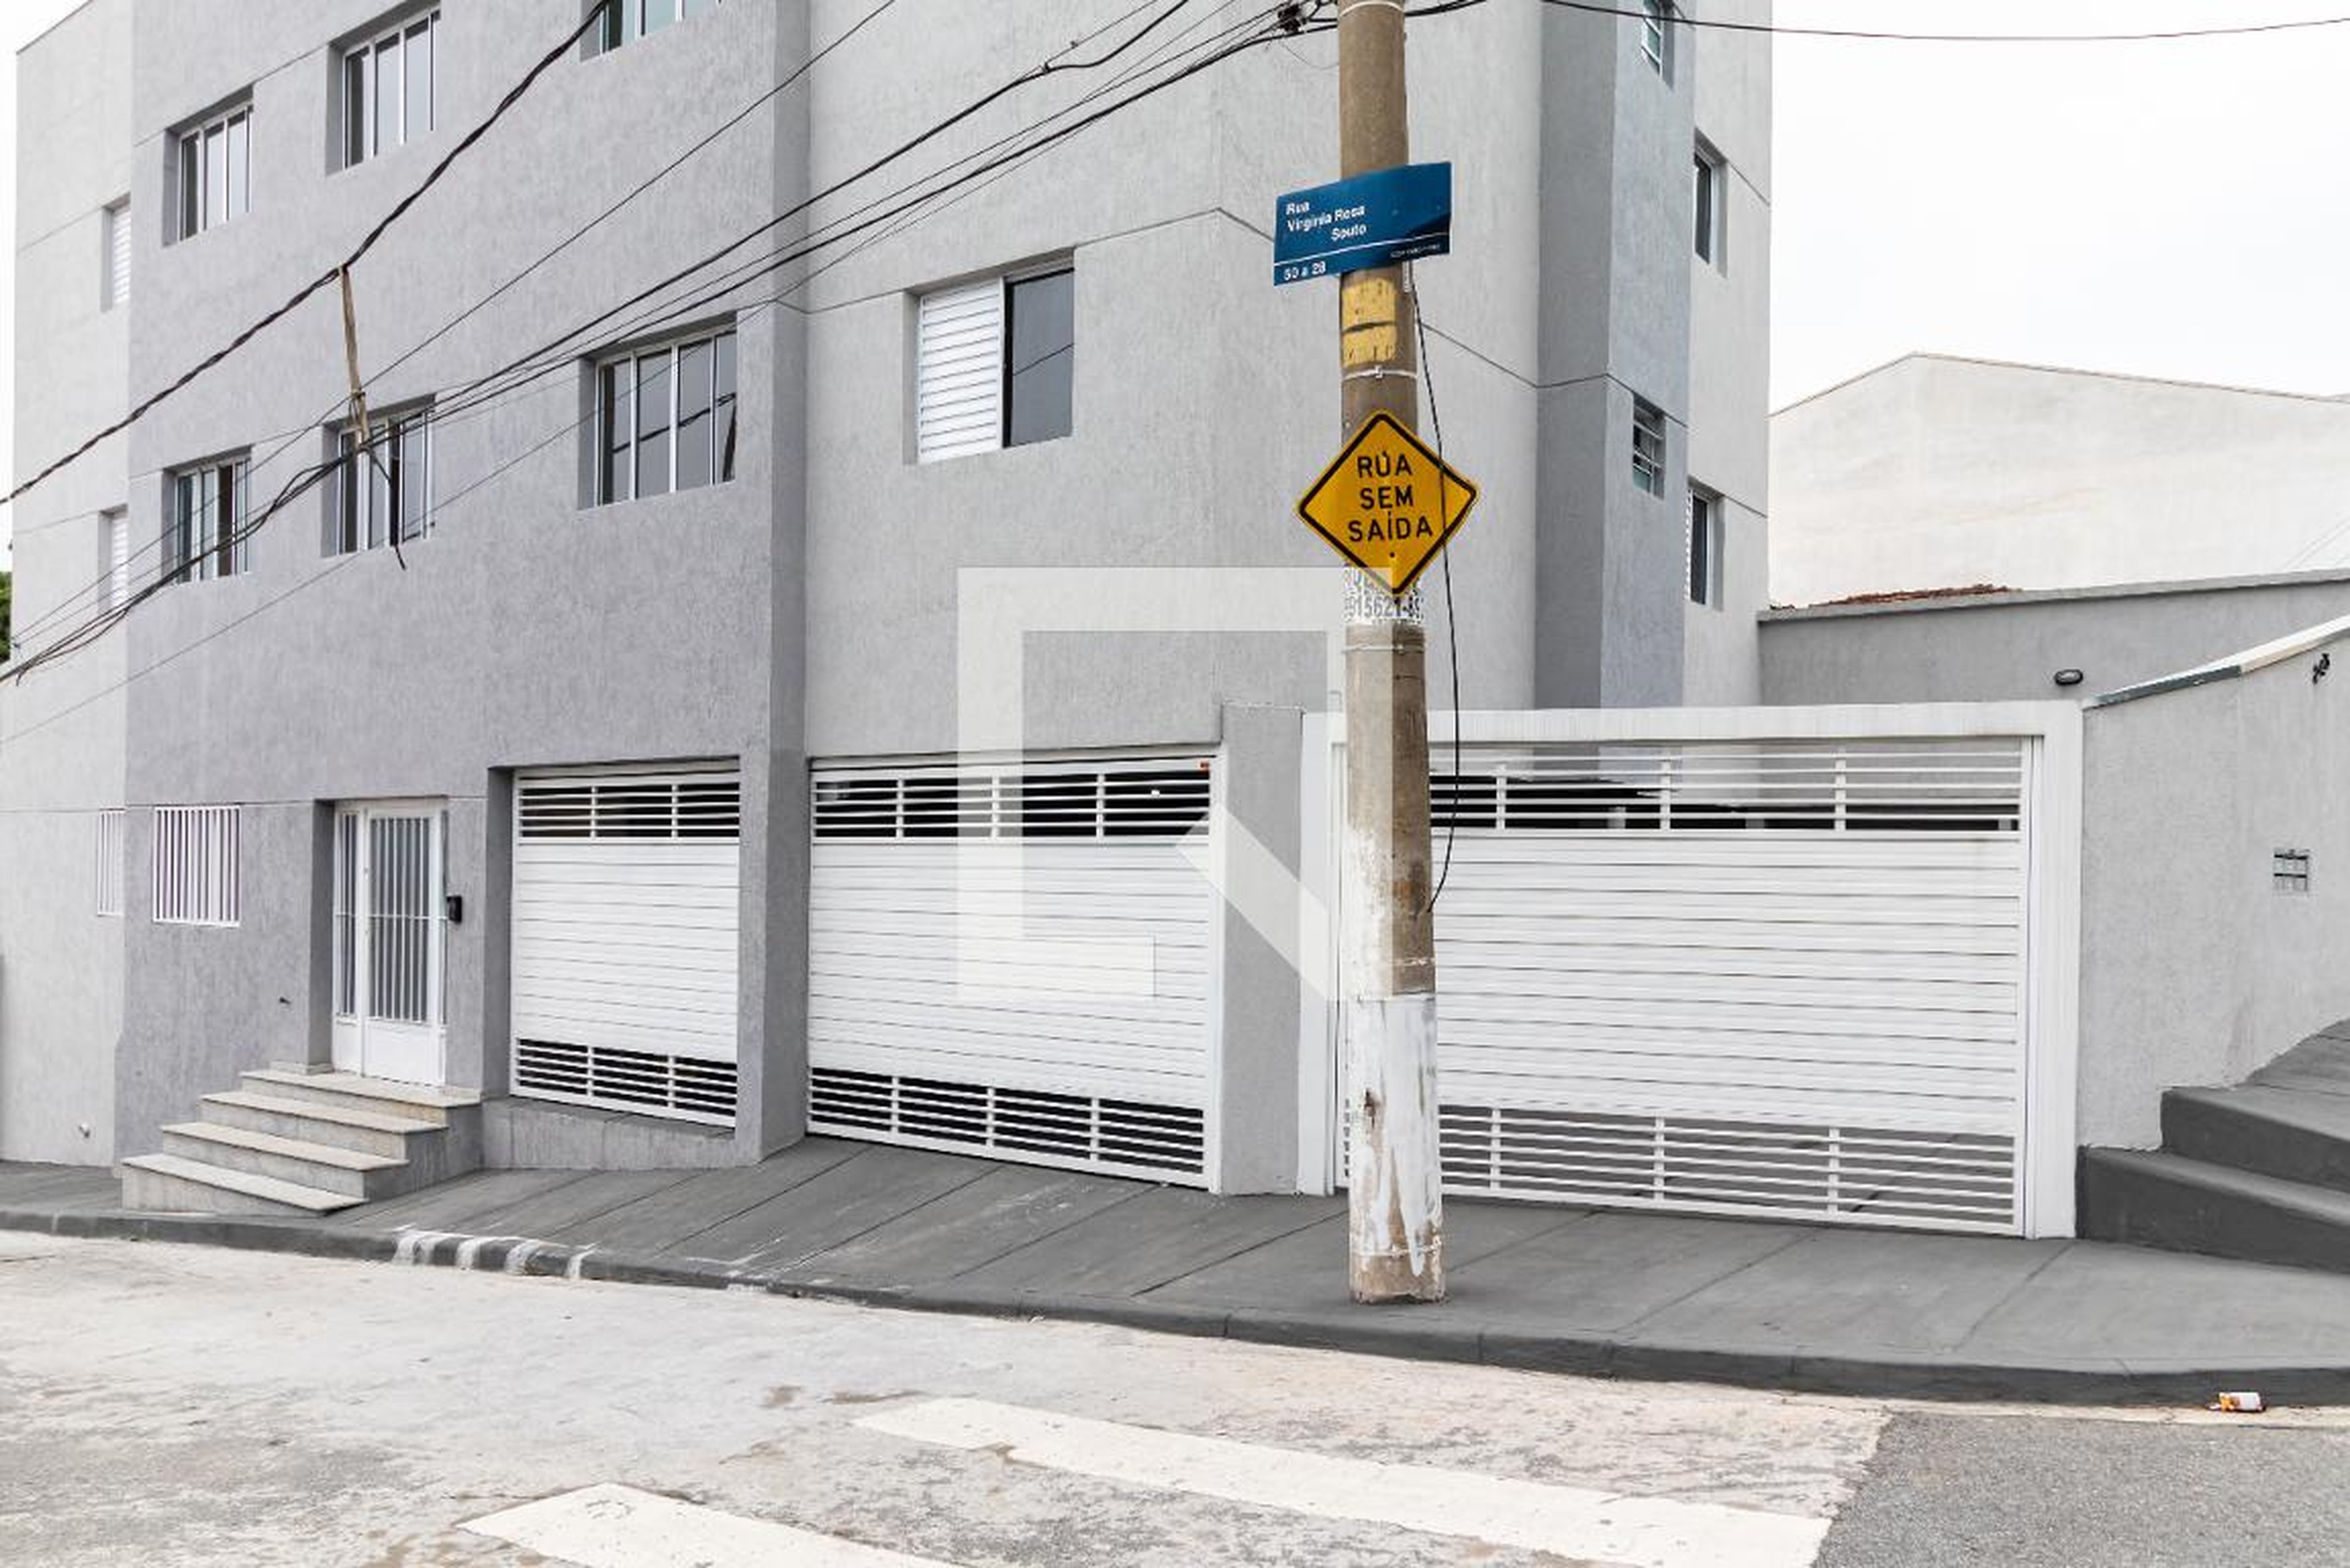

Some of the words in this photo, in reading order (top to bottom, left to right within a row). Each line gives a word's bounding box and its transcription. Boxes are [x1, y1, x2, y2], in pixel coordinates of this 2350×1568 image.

[1286, 201, 1310, 215] Rua
[1335, 206, 1365, 221] Rosa
[1331, 224, 1367, 241] Souto
[1357, 454, 1412, 478] RUA
[1360, 486, 1413, 509] SEM
[1348, 511, 1433, 542] SAÍDA
